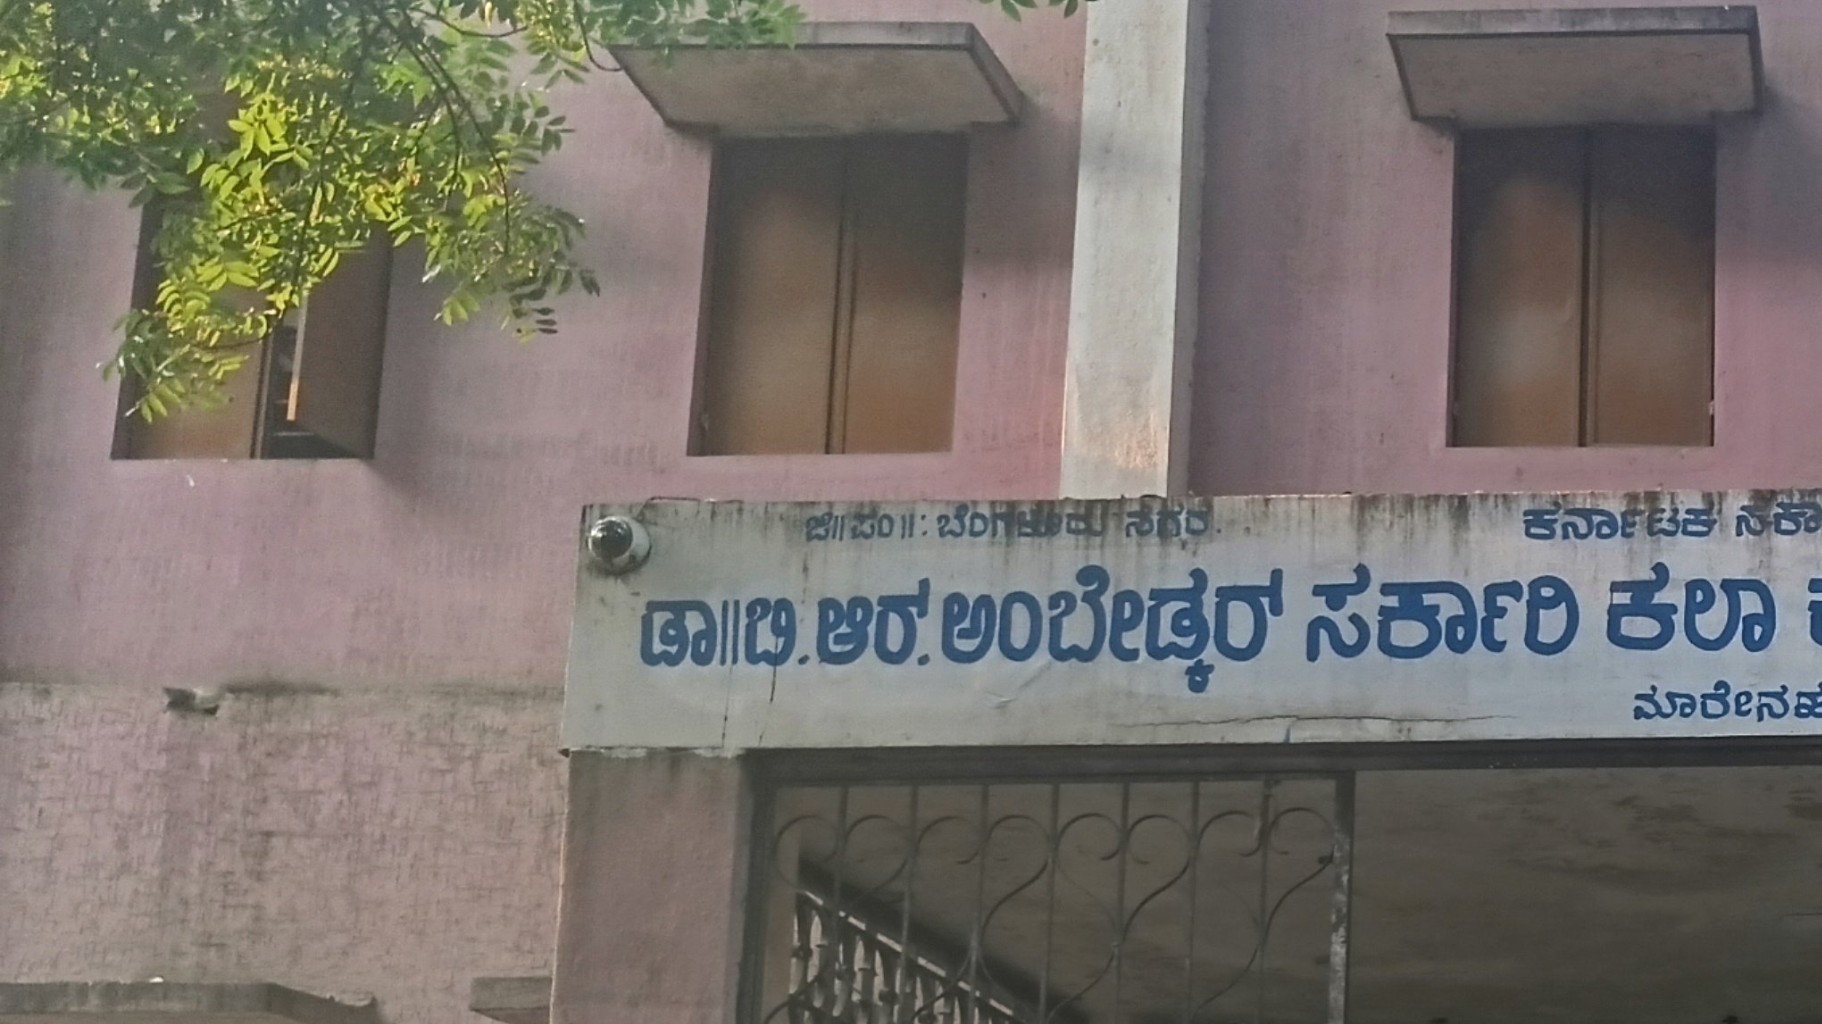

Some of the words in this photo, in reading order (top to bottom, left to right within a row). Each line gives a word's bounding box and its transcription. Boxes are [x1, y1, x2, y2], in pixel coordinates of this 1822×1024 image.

[1523, 501, 1717, 540] ಕರ್ನಾಟಕ
[1306, 564, 1580, 663] ಸರ್ಕಾರಿ
[1606, 562, 1777, 652] ಕಲಾ
